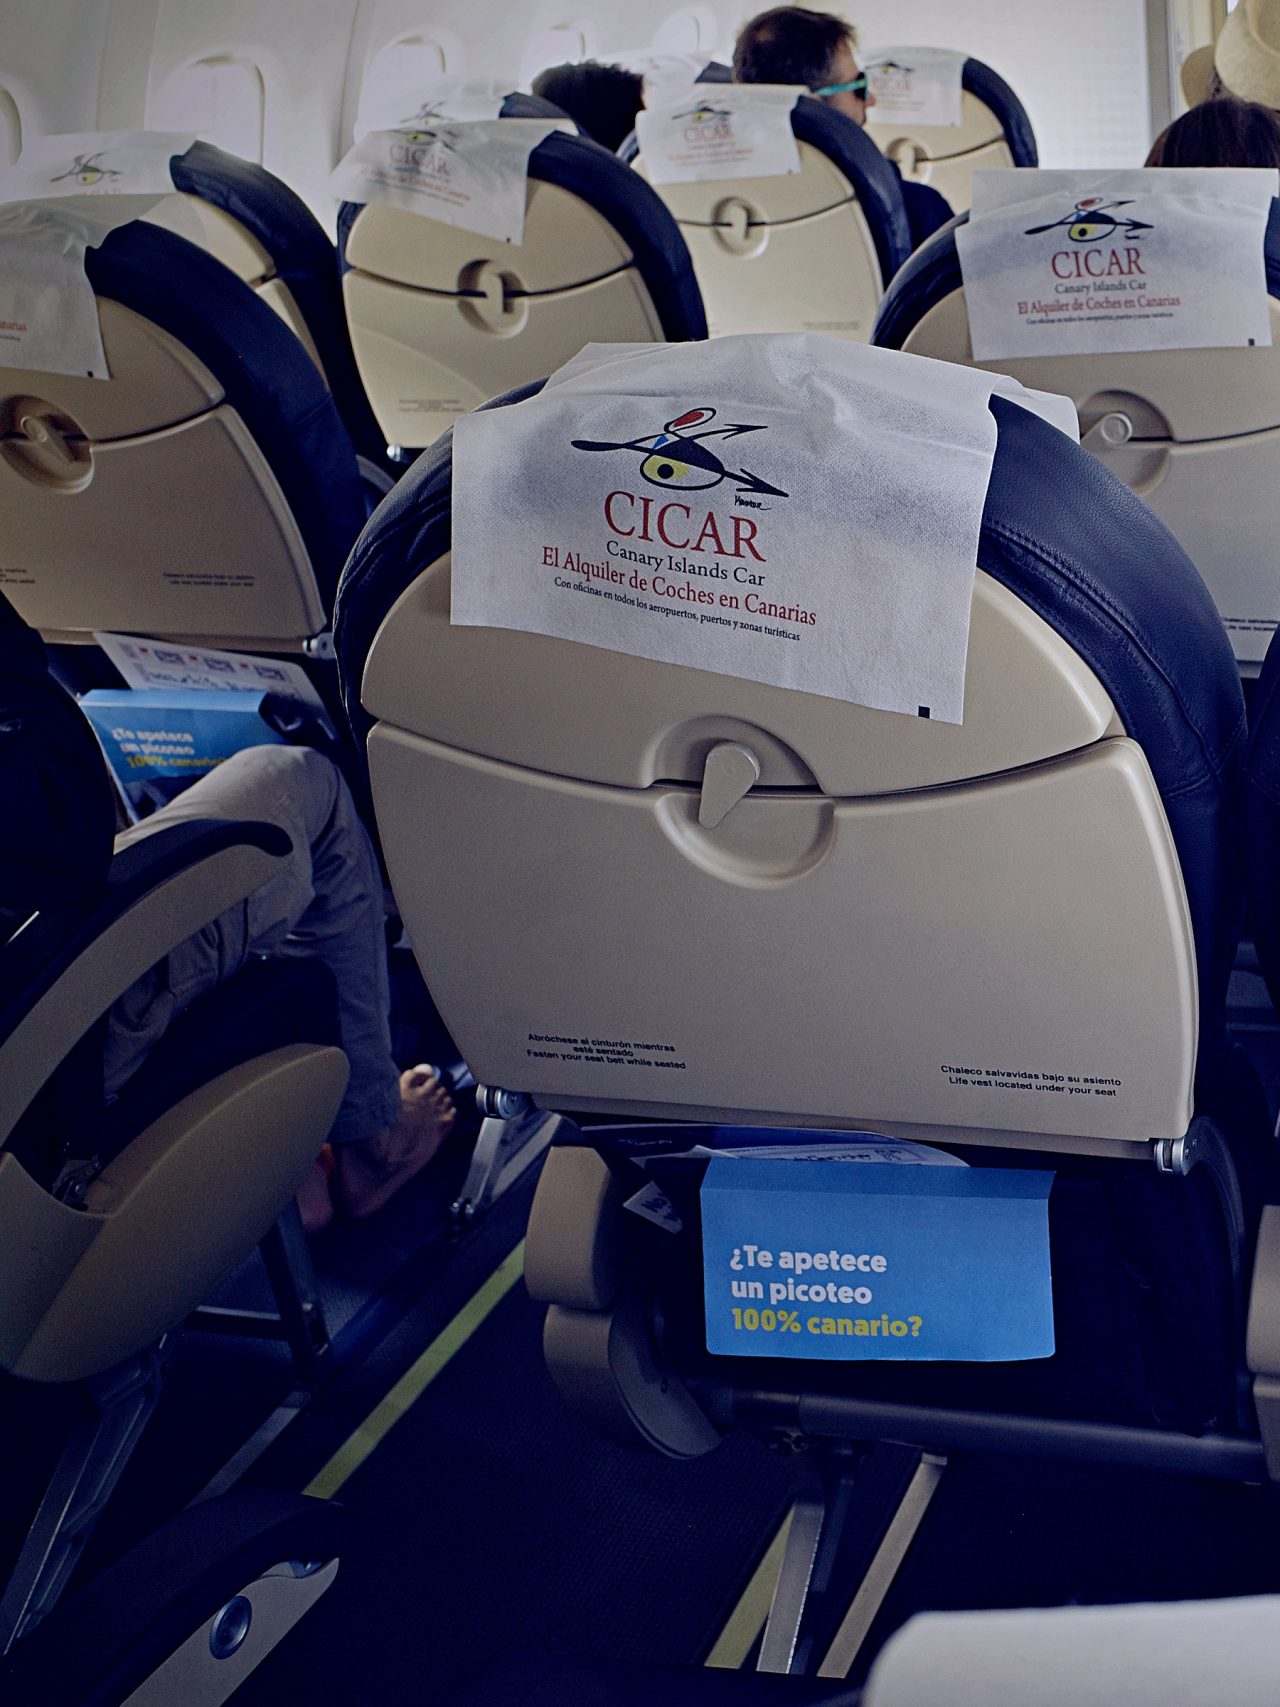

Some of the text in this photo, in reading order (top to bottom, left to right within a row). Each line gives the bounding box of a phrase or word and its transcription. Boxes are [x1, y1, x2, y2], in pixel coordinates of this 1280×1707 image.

[1051, 247, 1146, 279] CICAR
[1055, 280, 1147, 296] Canary Islands Car
[1017, 294, 1181, 317] El Alquiler de Coches en Canarias
[604, 491, 767, 562] CICAR
[606, 540, 765, 586] Canary Islands Car
[541, 546, 816, 625] El Alquiler de Coches en Canarias
[554, 576, 571, 588] Con
[574, 580, 602, 597] oficinas
[604, 591, 613, 600] en
[615, 592, 635, 607] todos
[637, 597, 648, 609] los
[649, 602, 699, 622] aeropuertos,
[700, 613, 732, 628] puertos
[733, 620, 738, 629] y
[740, 620, 762, 632] zonas
[528, 1033, 676, 1052] Abróchese el cinturón mientras
[573, 1044, 634, 1057] esté sentado
[527, 1049, 686, 1069] Fasten your seat belt while seated
[941, 1064, 1122, 1087] Chaleco salvavidas bajo su asiento
[948, 1076, 1117, 1097] Life vest located under your seat
[729, 1244, 888, 1275] ¿Te apetece
[731, 1276, 873, 1306] un picoteo
[731, 1307, 923, 1338] 100% canario?
